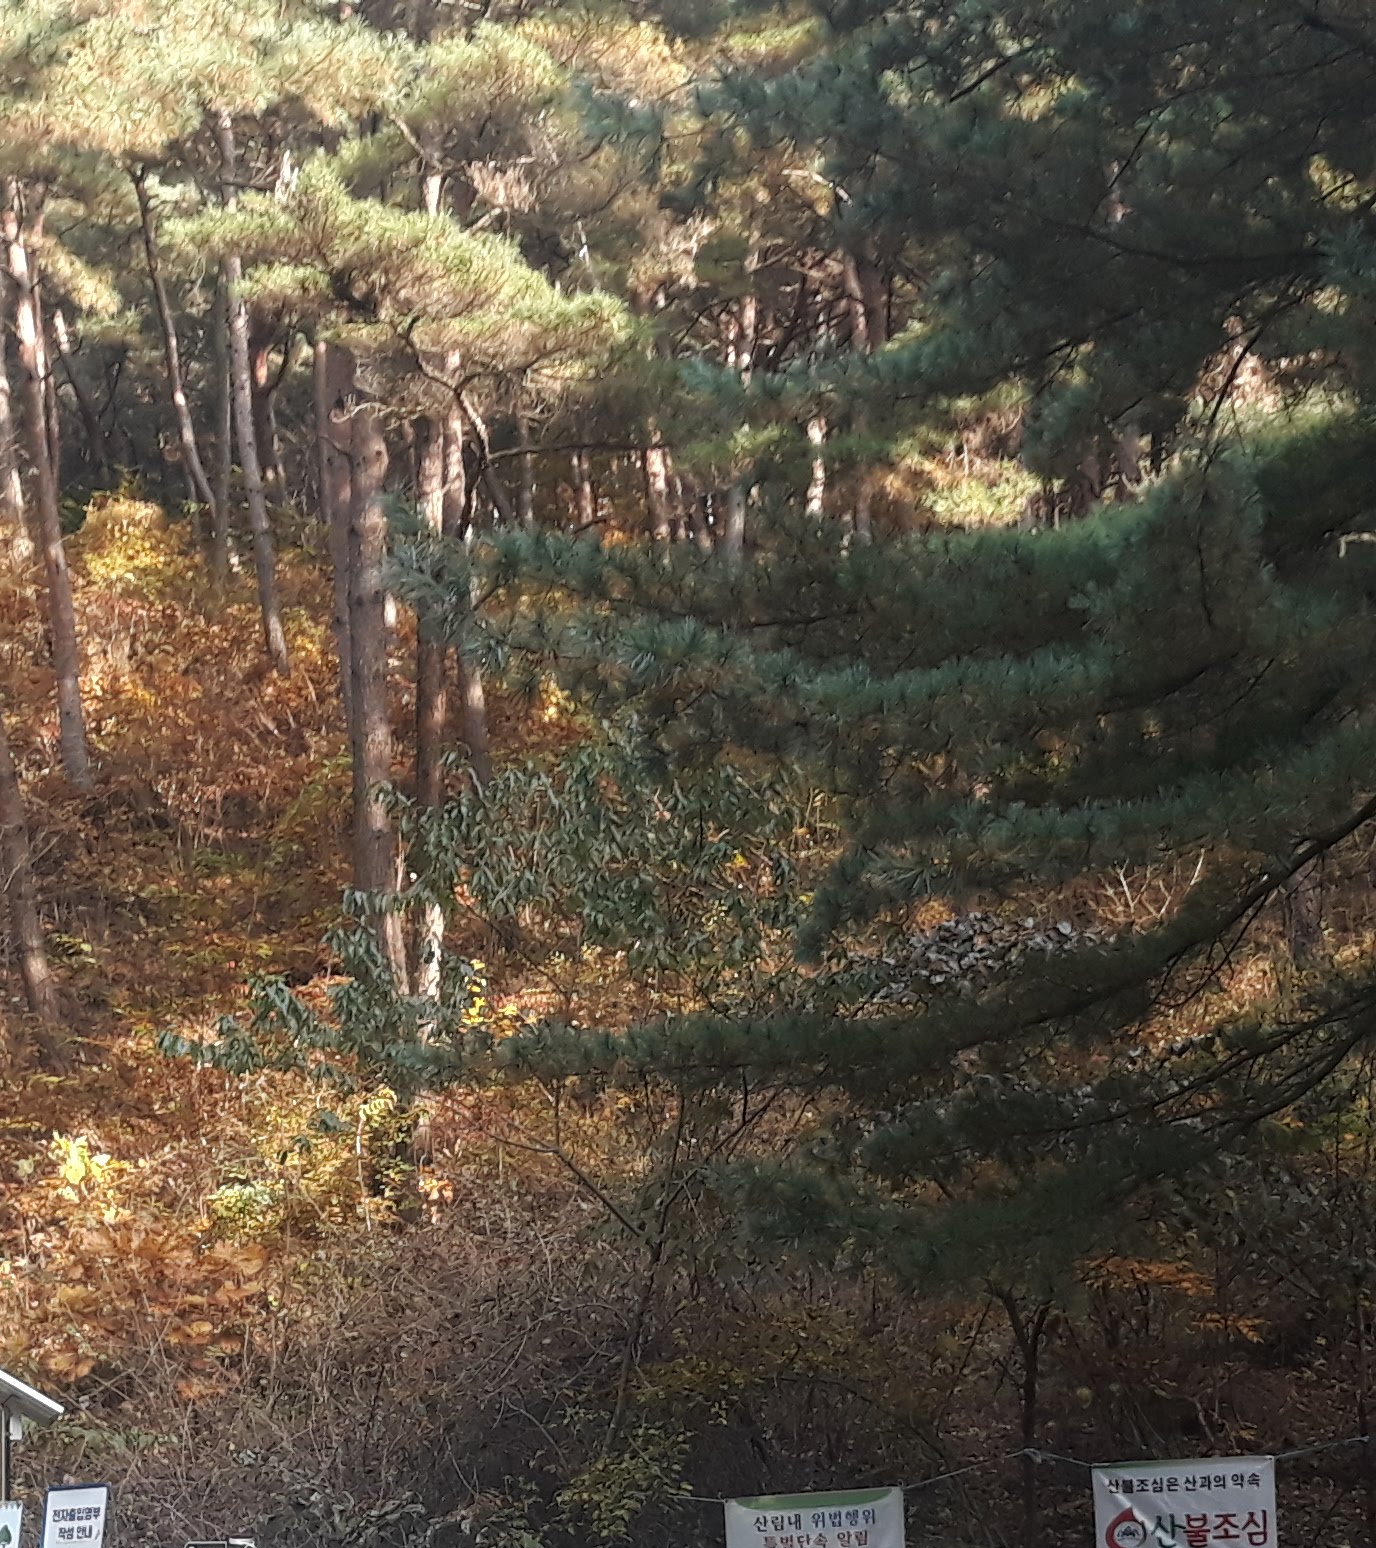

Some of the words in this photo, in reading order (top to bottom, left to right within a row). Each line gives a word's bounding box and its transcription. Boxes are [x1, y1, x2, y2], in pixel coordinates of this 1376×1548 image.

[1107, 1477, 1179, 1494] 산불조심은
[1184, 1475, 1225, 1491] 산과의
[1231, 1473, 1260, 1489] 약속
[753, 1514, 801, 1532] 산림내
[812, 1508, 876, 1528] 위법행위
[1151, 1509, 1267, 1548] 산불조심
[58, 1526, 73, 1539] 작성
[77, 1524, 93, 1539] 안내
[837, 1530, 868, 1547] 알림
